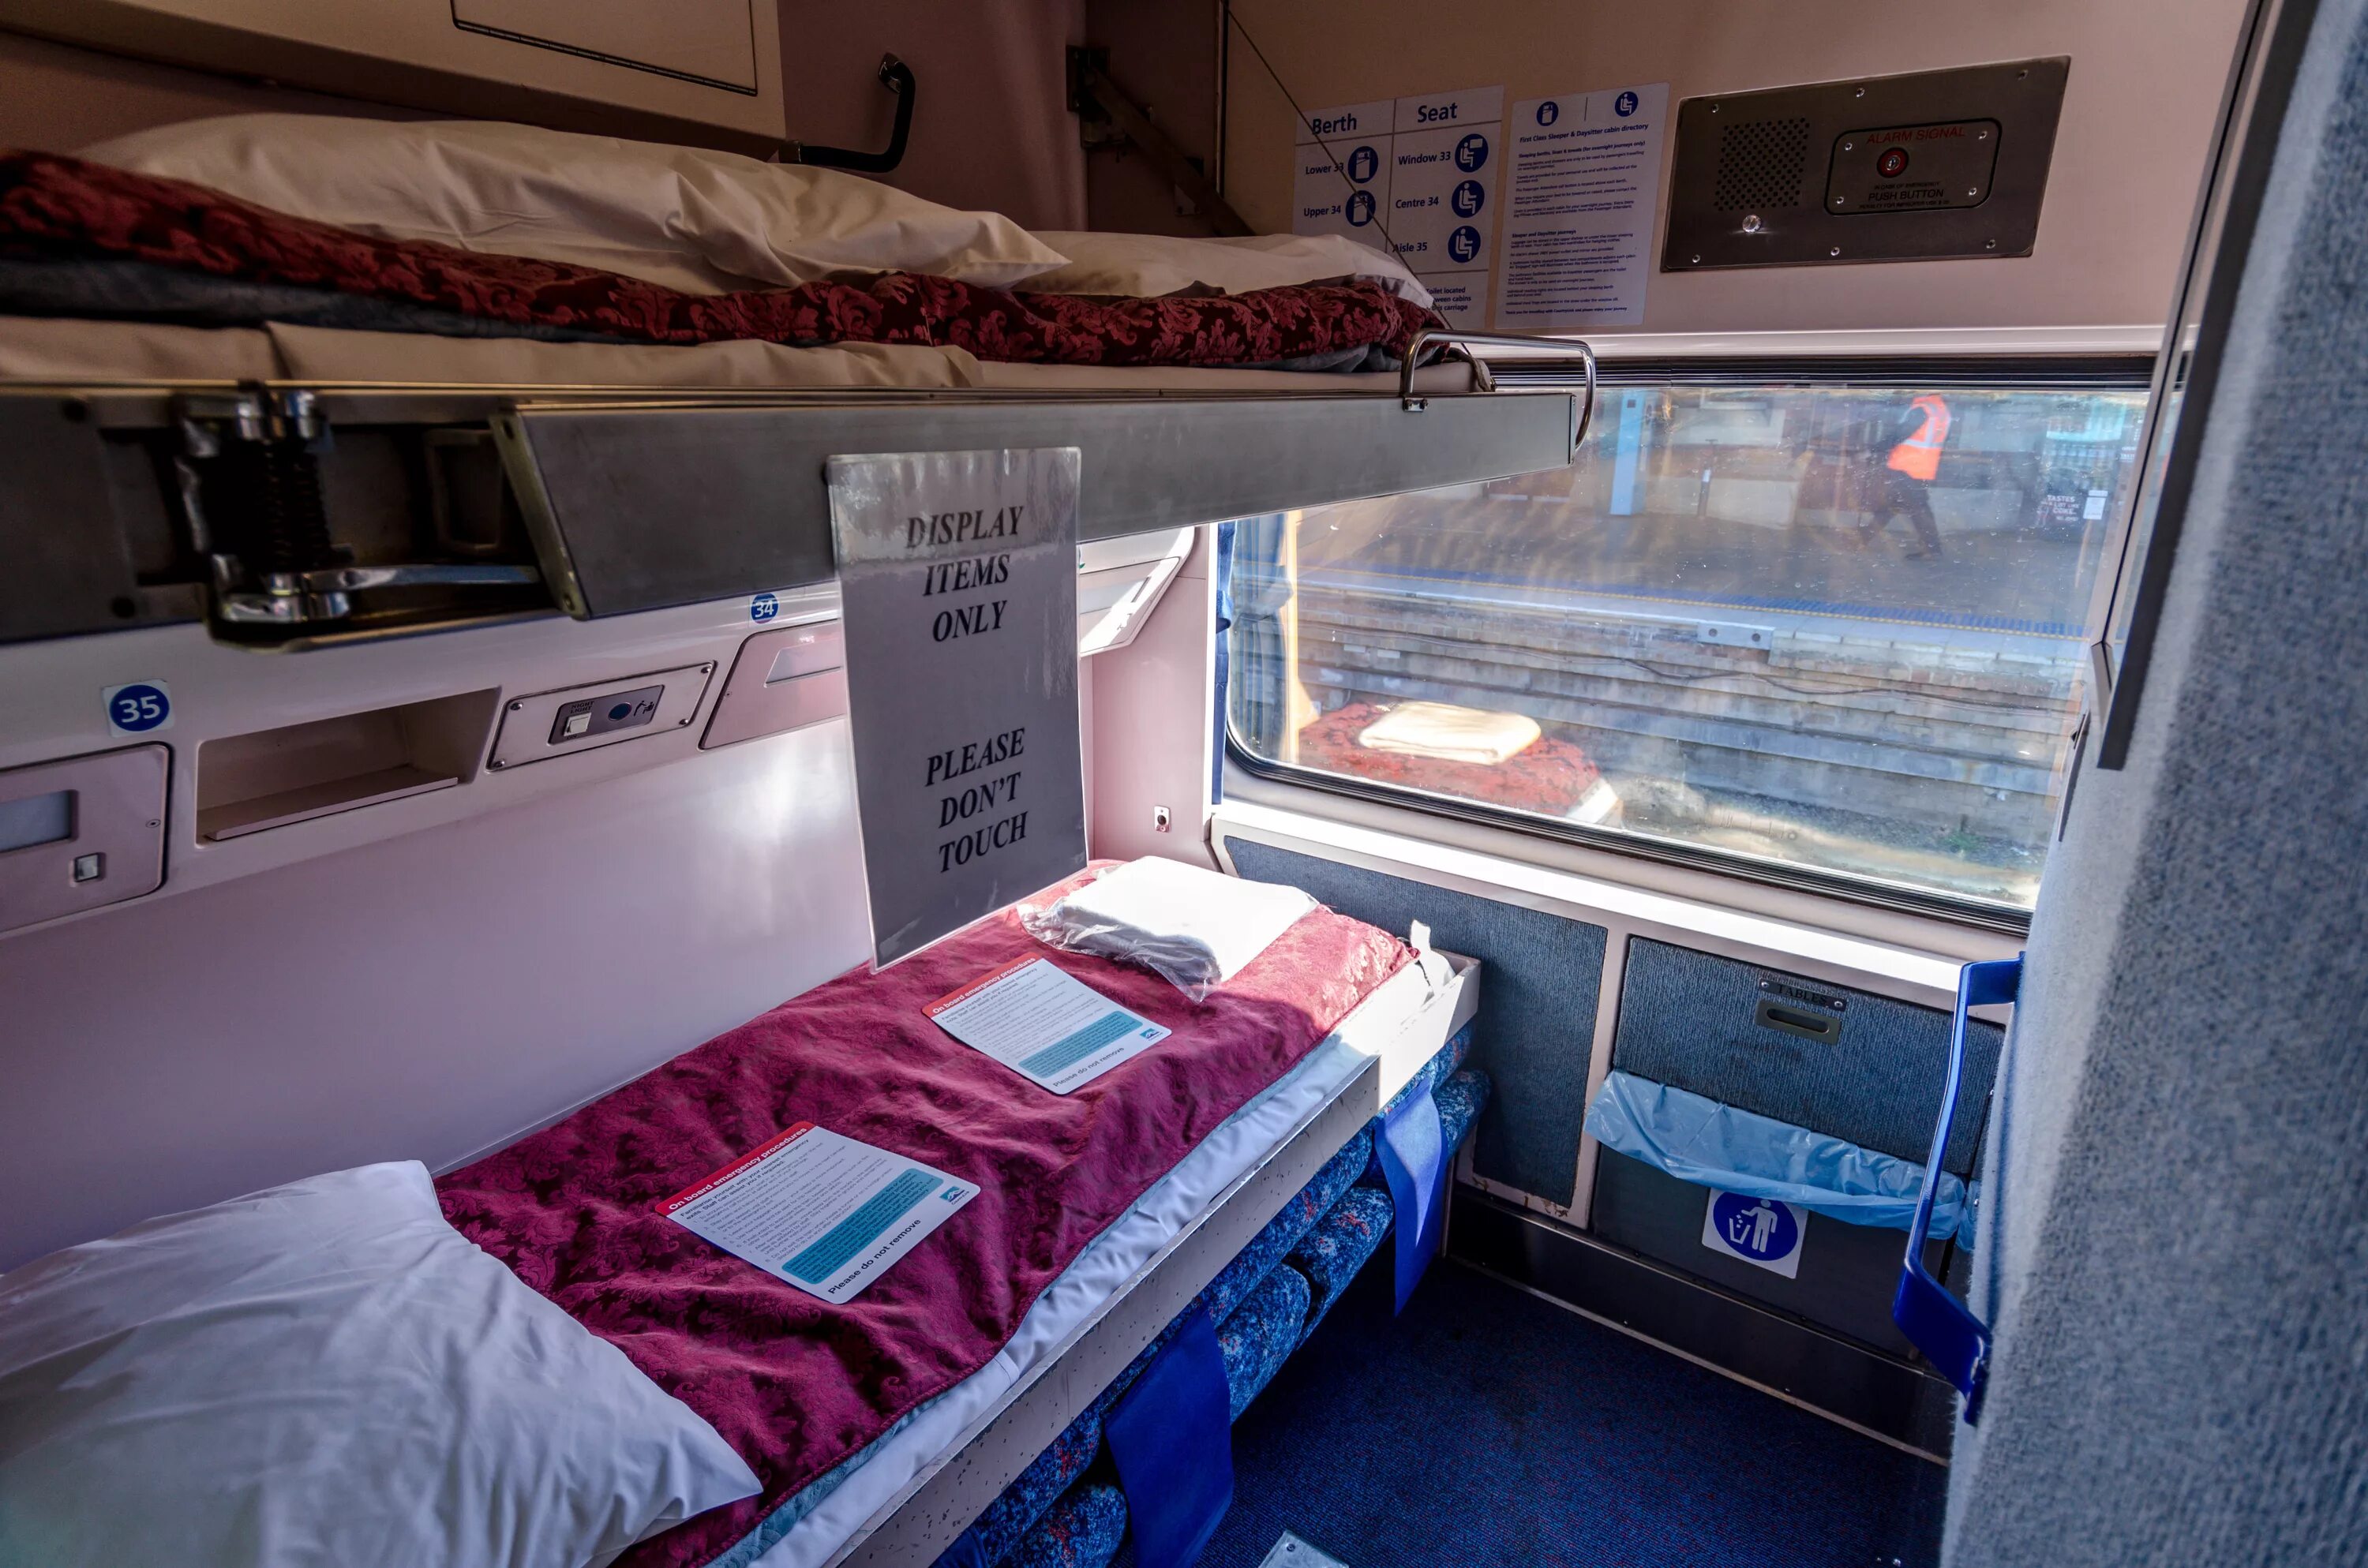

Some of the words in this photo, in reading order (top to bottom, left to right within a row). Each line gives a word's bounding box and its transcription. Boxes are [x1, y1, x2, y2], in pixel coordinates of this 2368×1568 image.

[1418, 102, 1458, 122] Seat
[1312, 113, 1357, 135] Berth
[1548, 131, 1569, 140] Sleeper
[1576, 127, 1603, 137] Daysitter
[1621, 122, 1648, 133] directory
[1866, 130, 1913, 145] ALARM
[1916, 126, 1966, 140] SIGNAL
[1306, 164, 1332, 175] Lower
[1334, 163, 1344, 172] 33
[1398, 153, 1437, 166] Window
[1440, 152, 1451, 161] 33
[1396, 198, 1426, 209] Centre
[1428, 196, 1439, 207] 34
[1868, 192, 1898, 202] PUSH
[1899, 189, 1945, 200] BUTTON
[1303, 207, 1329, 218] Upper
[1331, 205, 1341, 215] 34
[1393, 242, 1414, 253] Aisle
[1417, 241, 1428, 251] 35
[905, 504, 1026, 550] DISPLAY
[922, 554, 1012, 597] ITEMS
[754, 600, 775, 618] 34
[932, 600, 1009, 642] ONLY
[118, 694, 161, 724] 35
[924, 727, 1027, 788] PLEASE
[939, 810, 1029, 874] TOUCH
[1778, 983, 1827, 1007] TABLES
[1052, 1072, 1078, 1087] Please
[1085, 1060, 1100, 1068] not
[1098, 1046, 1125, 1061] remove
[666, 1199, 686, 1210] On
[682, 1184, 714, 1201] board
[711, 1156, 763, 1185] emergency
[759, 1127, 808, 1158] procedures
[826, 1269, 862, 1294] Please
[858, 1258, 875, 1270] do
[871, 1245, 890, 1259] not
[888, 1218, 921, 1245] remove
